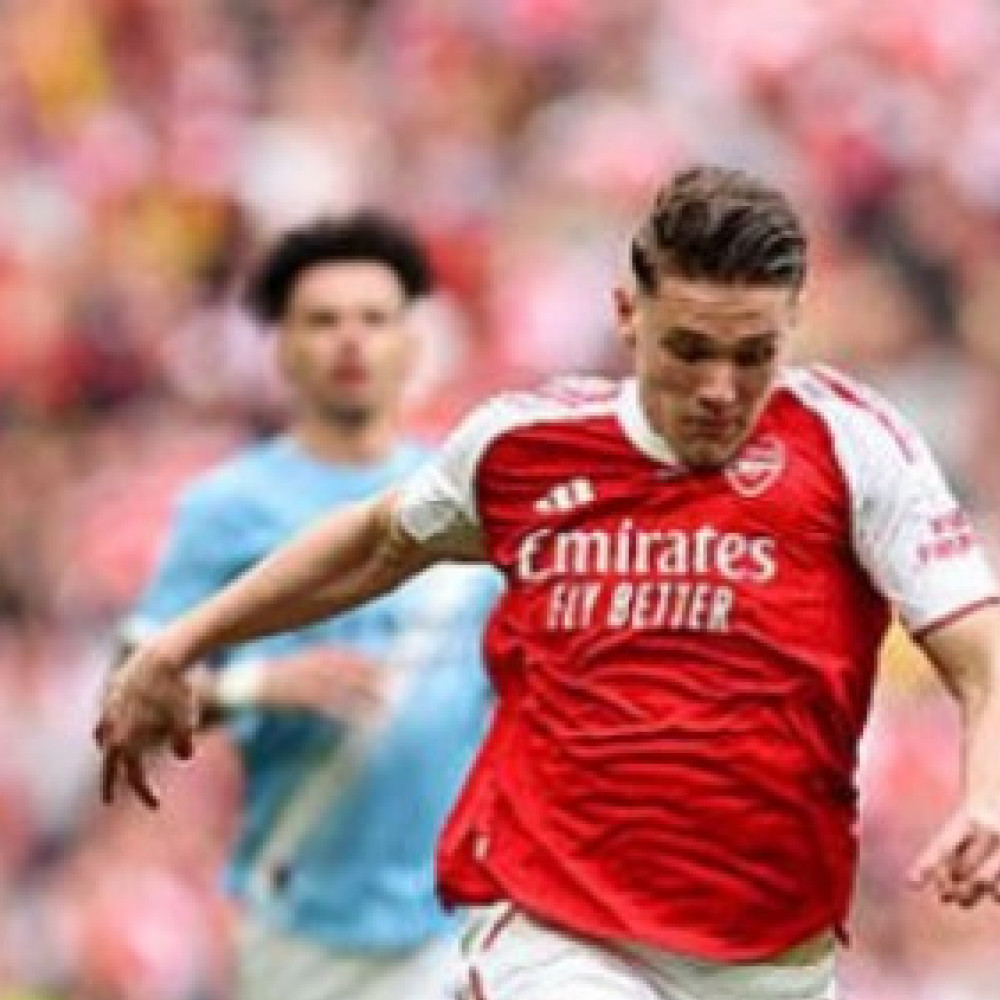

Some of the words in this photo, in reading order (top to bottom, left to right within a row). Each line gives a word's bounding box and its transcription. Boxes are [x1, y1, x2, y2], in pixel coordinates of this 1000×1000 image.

[517, 517, 777, 584] Emirates
[545, 581, 602, 632] FLY
[605, 581, 737, 634] BETTER
